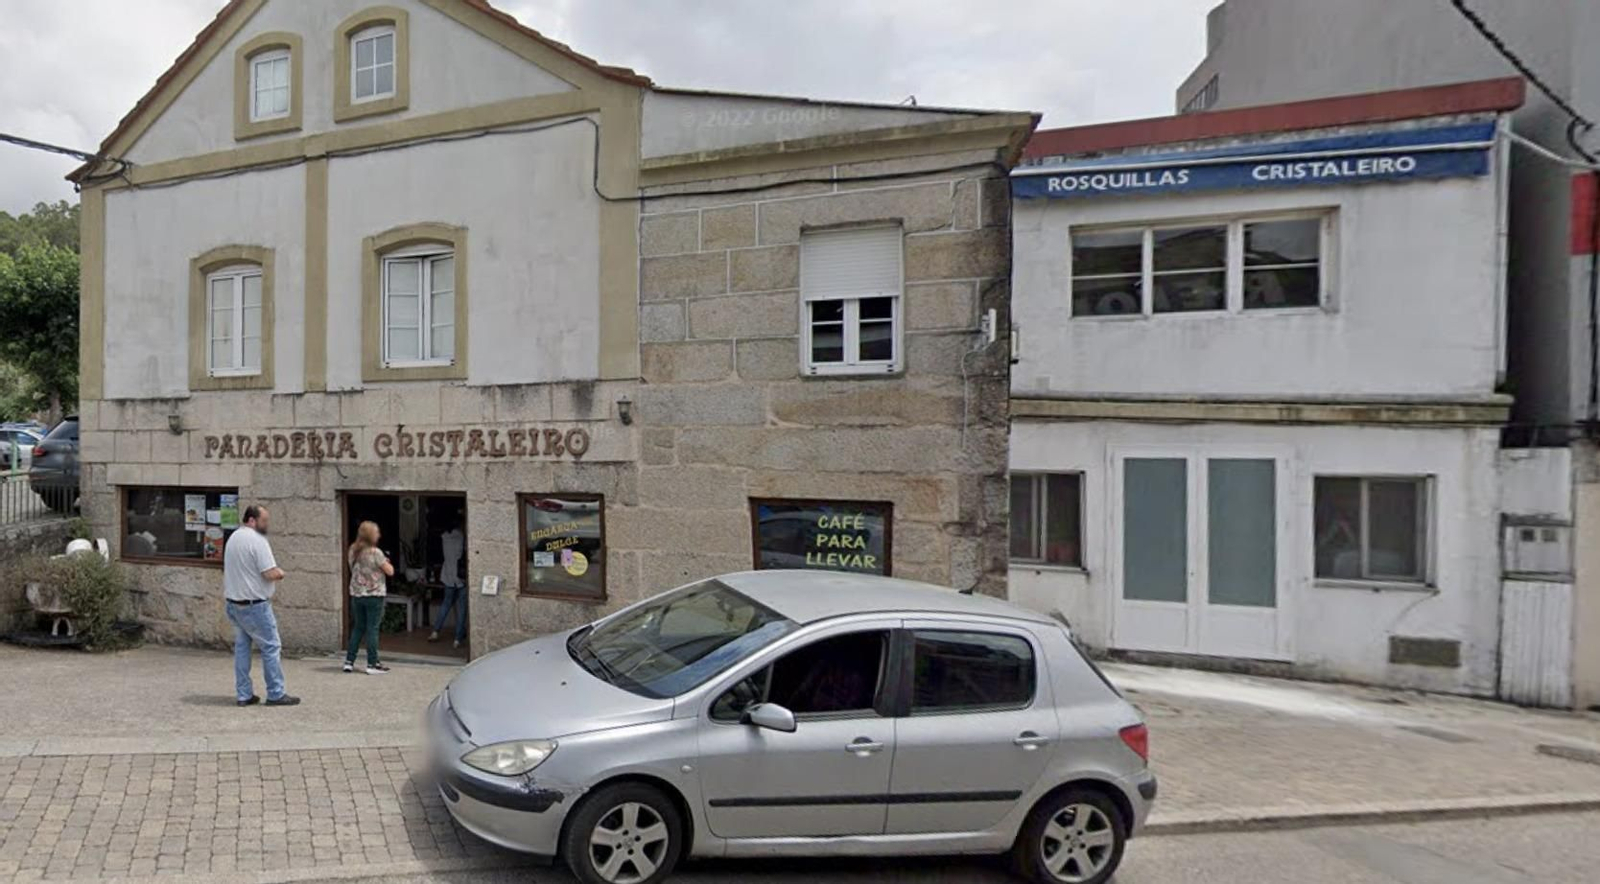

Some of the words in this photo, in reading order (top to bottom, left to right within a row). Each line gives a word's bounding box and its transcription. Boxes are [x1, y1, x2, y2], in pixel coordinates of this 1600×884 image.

[1048, 169, 1190, 192] ROSQUILLAS
[1252, 156, 1416, 181] CRISTALEIRO
[373, 427, 590, 460] CRISTALEIRO
[817, 512, 866, 530] CAFÉ
[816, 533, 866, 550] PARA
[805, 552, 877, 569] LLEVAR
